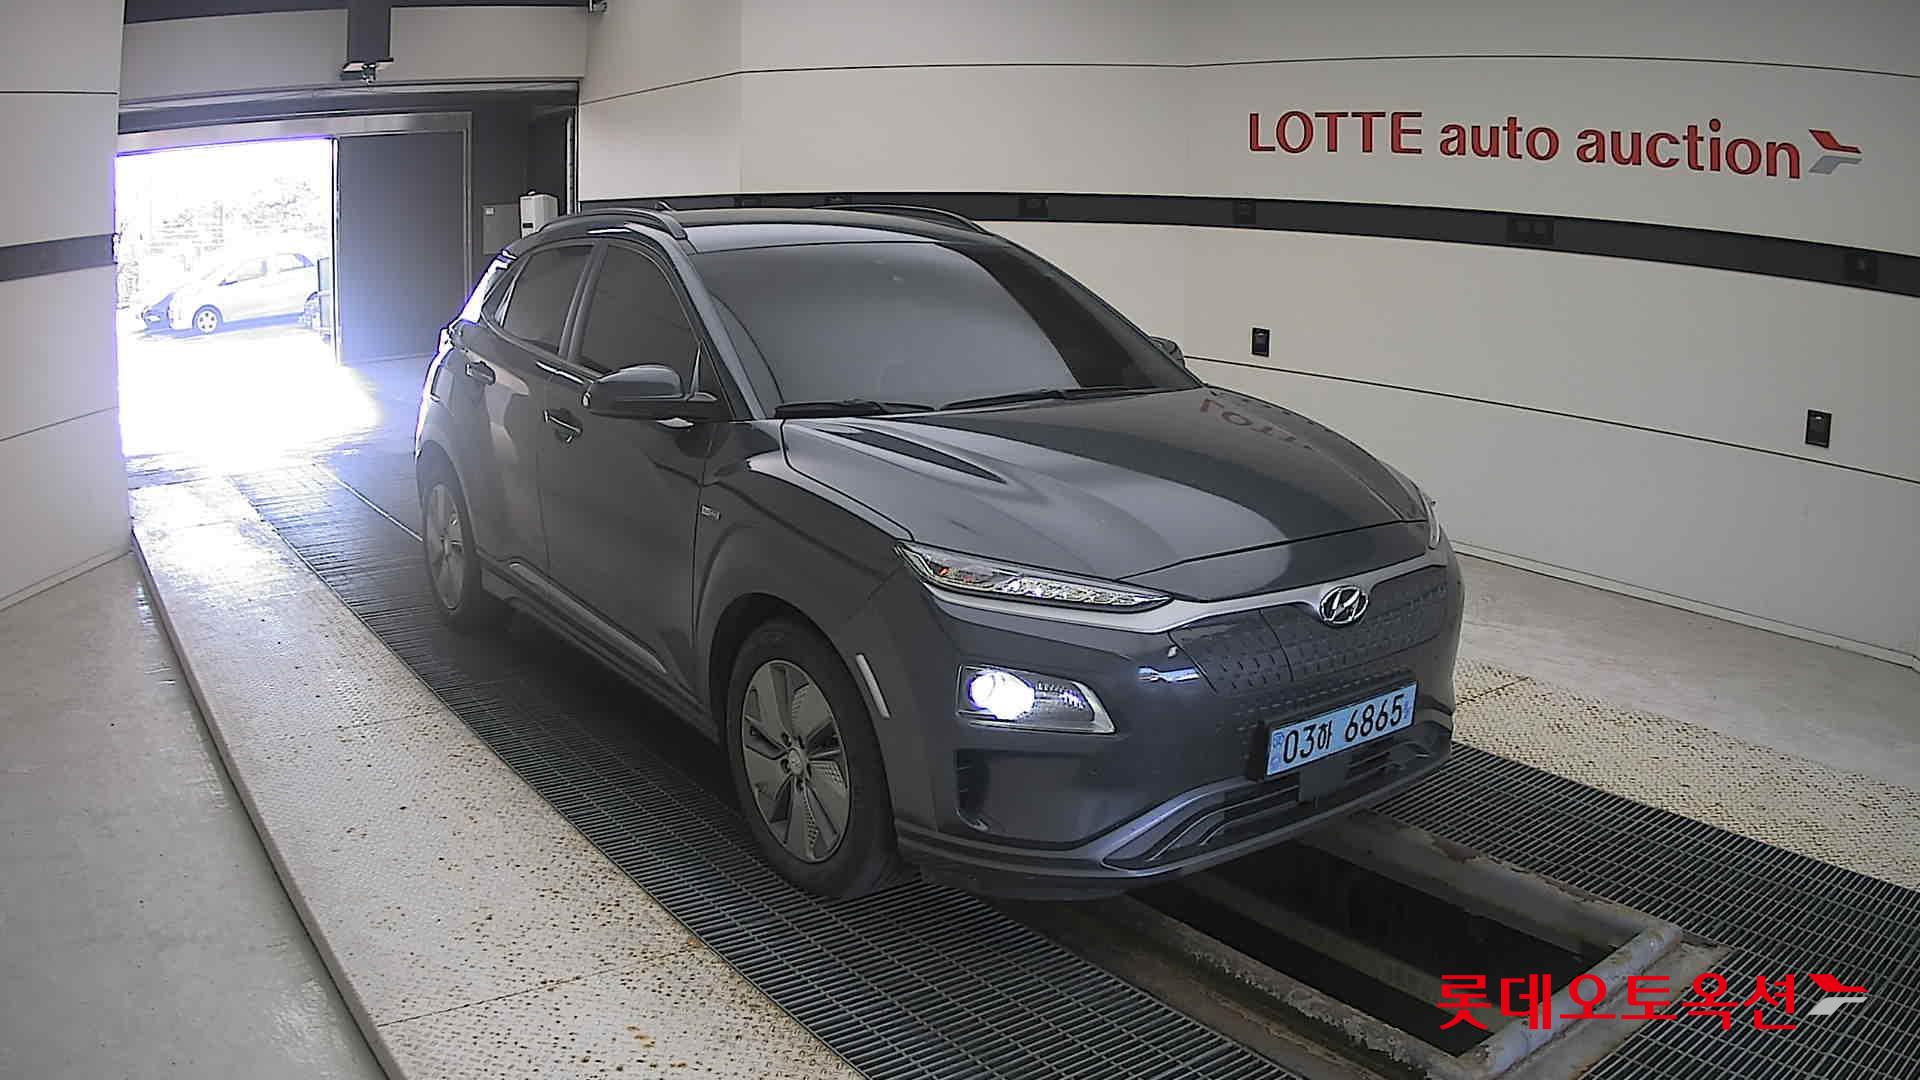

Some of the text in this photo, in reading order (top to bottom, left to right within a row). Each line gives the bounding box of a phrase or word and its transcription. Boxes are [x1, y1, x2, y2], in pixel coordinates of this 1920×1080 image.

[1249, 111, 1801, 179] LOTTE auto auction
[1283, 720, 1333, 764] 03하
[1344, 693, 1404, 743] 6865
